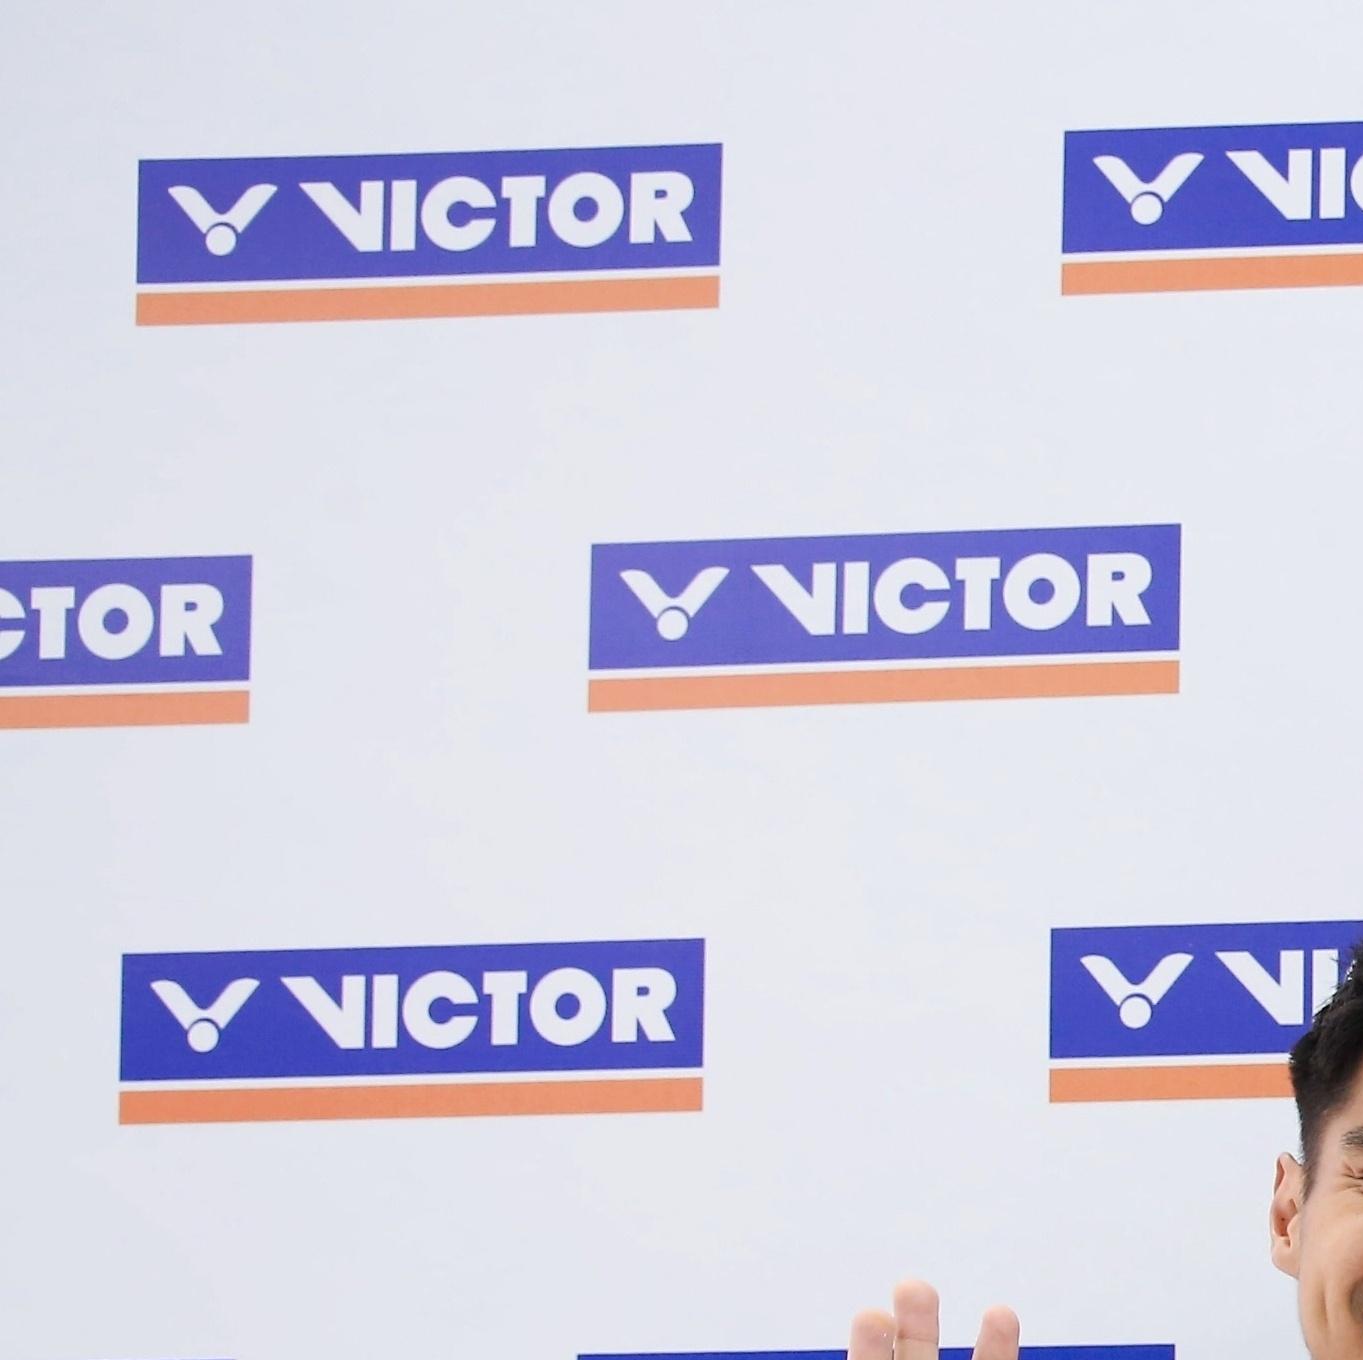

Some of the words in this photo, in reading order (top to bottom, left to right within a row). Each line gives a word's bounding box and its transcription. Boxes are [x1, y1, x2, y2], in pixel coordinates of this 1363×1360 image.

[299, 171, 694, 252] VICTOR
[750, 553, 1152, 634] VICTOR
[281, 967, 676, 1052] VICTOR
